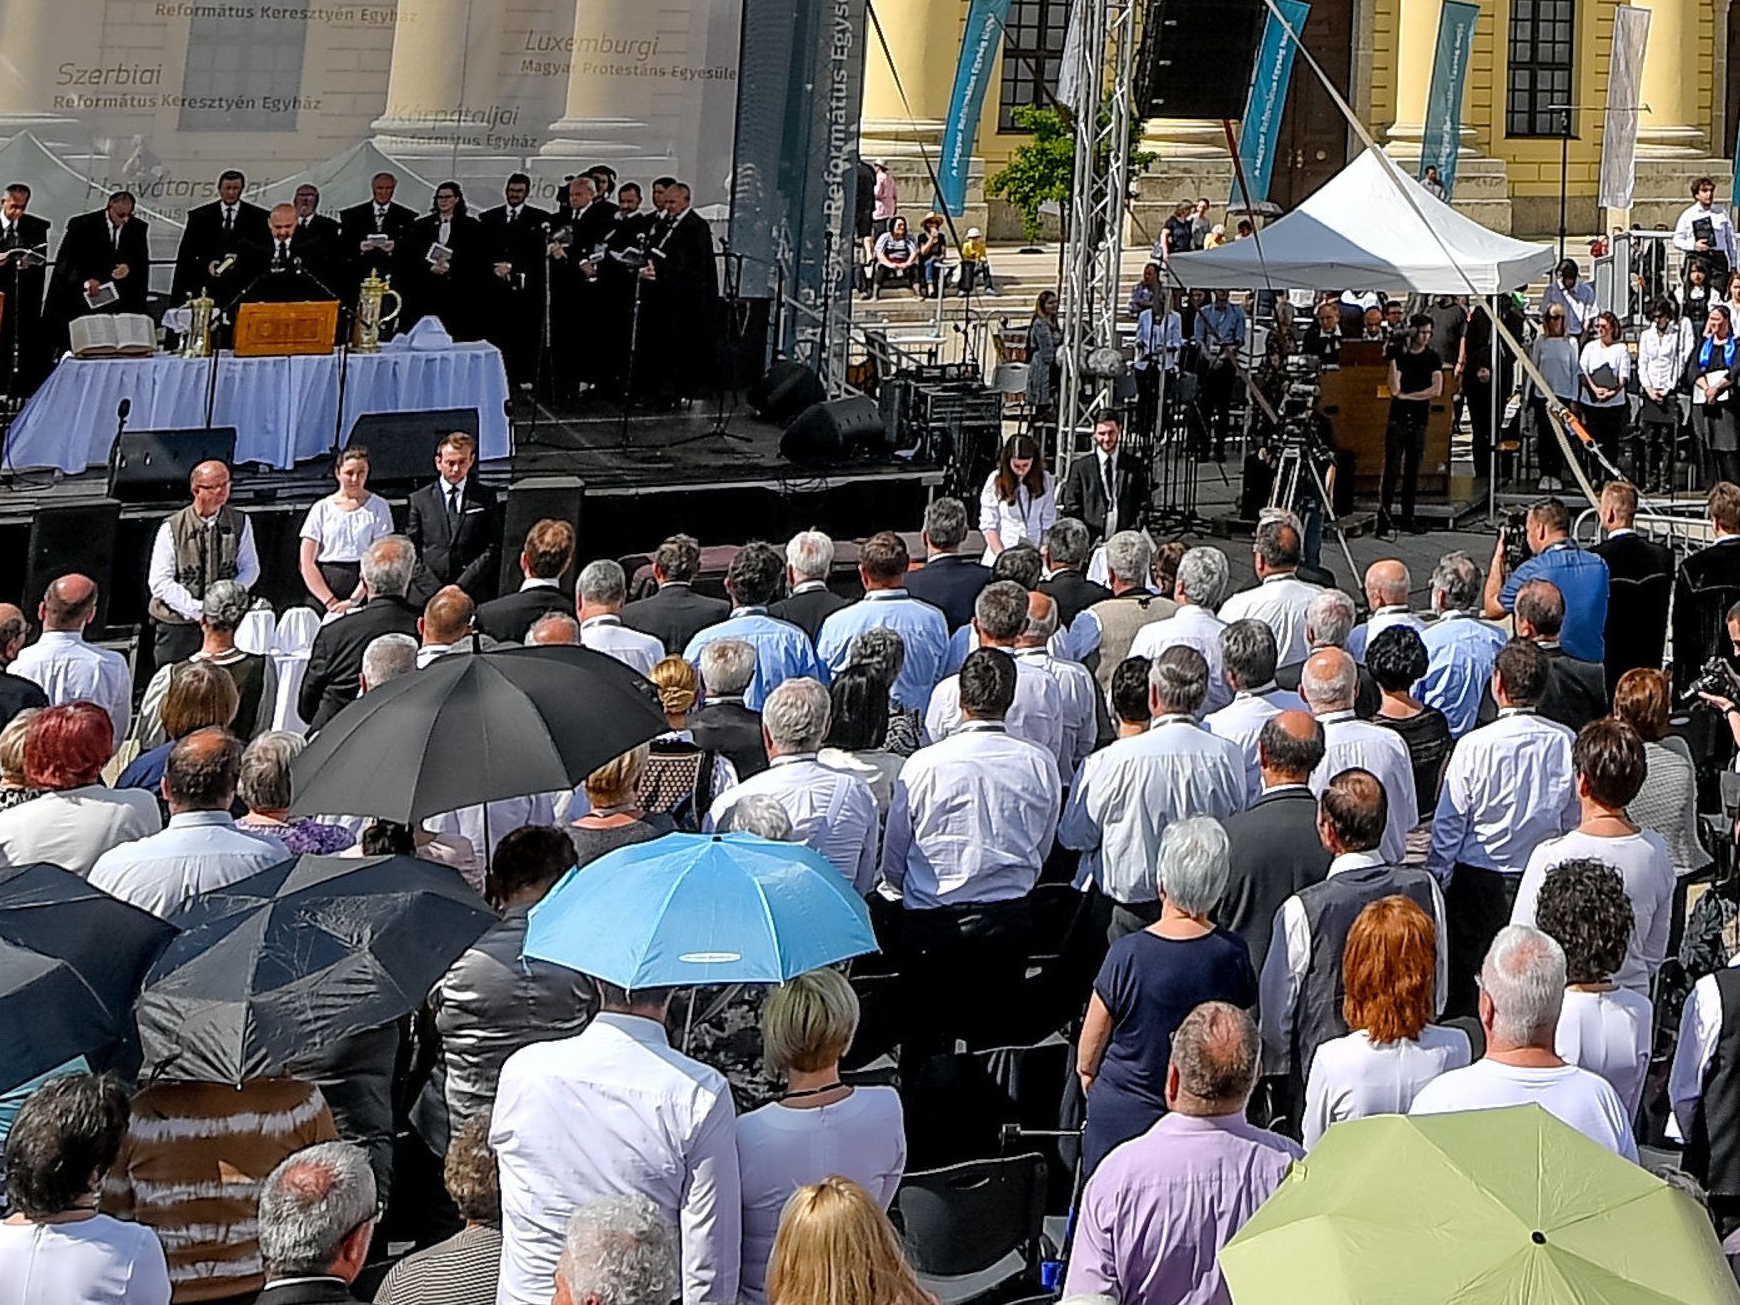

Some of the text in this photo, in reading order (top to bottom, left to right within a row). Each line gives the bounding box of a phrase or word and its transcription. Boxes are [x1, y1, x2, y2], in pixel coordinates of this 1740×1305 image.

[154, 3, 255, 20] Református
[259, 5, 355, 23] Keresztyén
[524, 29, 661, 62] Luxemburgi
[55, 62, 163, 86] Szerbiai
[520, 59, 738, 82] Magyar Protestáns Egyesüle
[53, 93, 322, 114] Református Keresztyén Egyház
